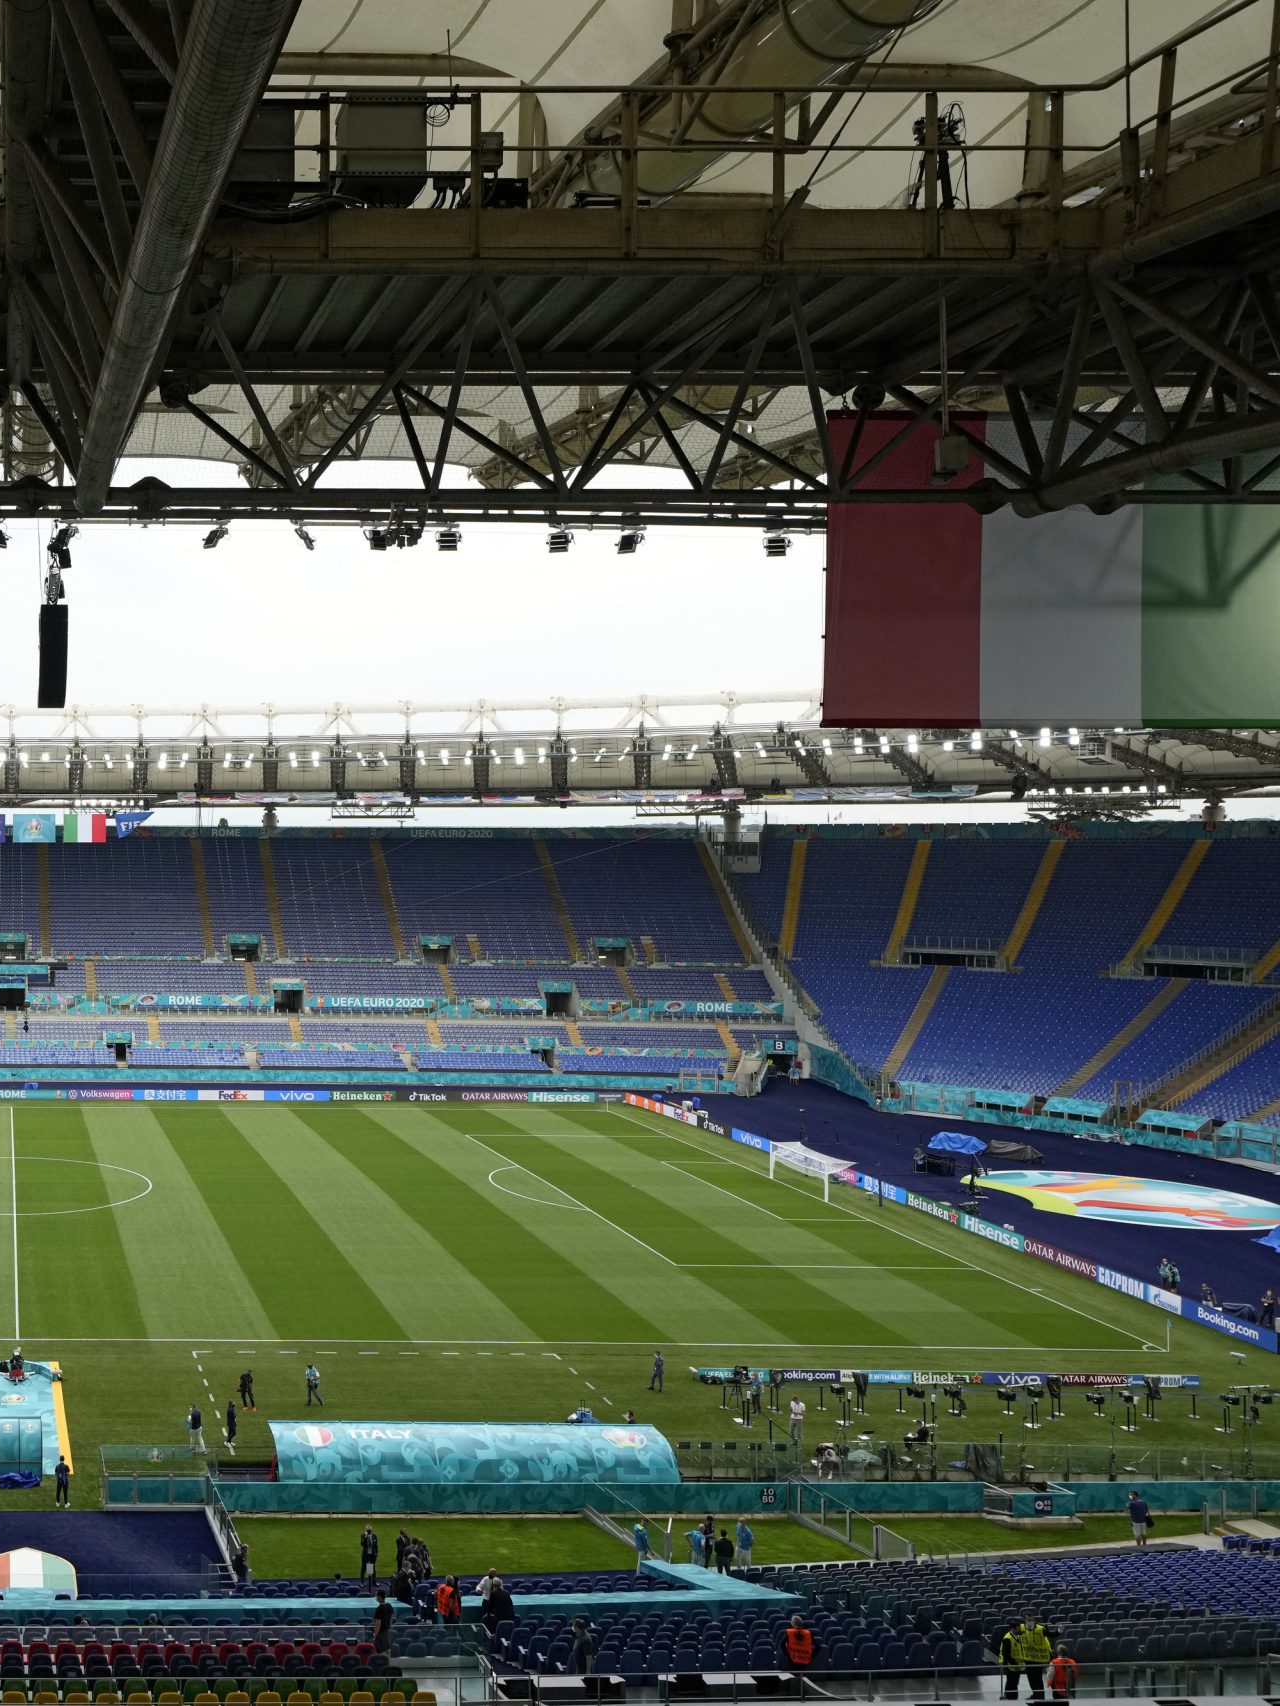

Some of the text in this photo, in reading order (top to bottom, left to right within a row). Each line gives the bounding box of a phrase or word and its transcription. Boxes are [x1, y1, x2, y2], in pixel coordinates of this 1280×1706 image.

[211, 828, 241, 837] ROME
[410, 829, 493, 838] UEFA EURO 2020
[169, 996, 202, 1005] ROME
[331, 998, 424, 1008] UEFA EURO 2020
[696, 1002, 733, 1012] ROME
[775, 1042, 784, 1050] B
[80, 1089, 130, 1099] Volkswagen
[218, 1090, 248, 1100] FedEx
[280, 1091, 314, 1100] vivo
[333, 1091, 382, 1100] Heineken
[419, 1093, 447, 1101] TikTok
[462, 1092, 528, 1101] QATAR AIRWAYS
[532, 1092, 590, 1102] Hisense
[674, 1108, 689, 1121] FedEx
[708, 1122, 724, 1135] TikTok
[740, 1132, 762, 1149] vivo
[907, 1194, 950, 1221] Heineken
[964, 1216, 1019, 1249] Hisense
[1023, 1239, 1097, 1277] QATAR AIRWAYS
[1098, 1266, 1144, 1300] GAZPROM
[1197, 1306, 1260, 1340] Booking.com
[783, 1369, 836, 1381] oking.com
[998, 1373, 1041, 1384] vivo
[1087, 1374, 1127, 1383] AIRWAYS
[1160, 1376, 1182, 1386] PROM
[347, 1429, 413, 1439] ITALY
[762, 1495, 775, 1503] BD
